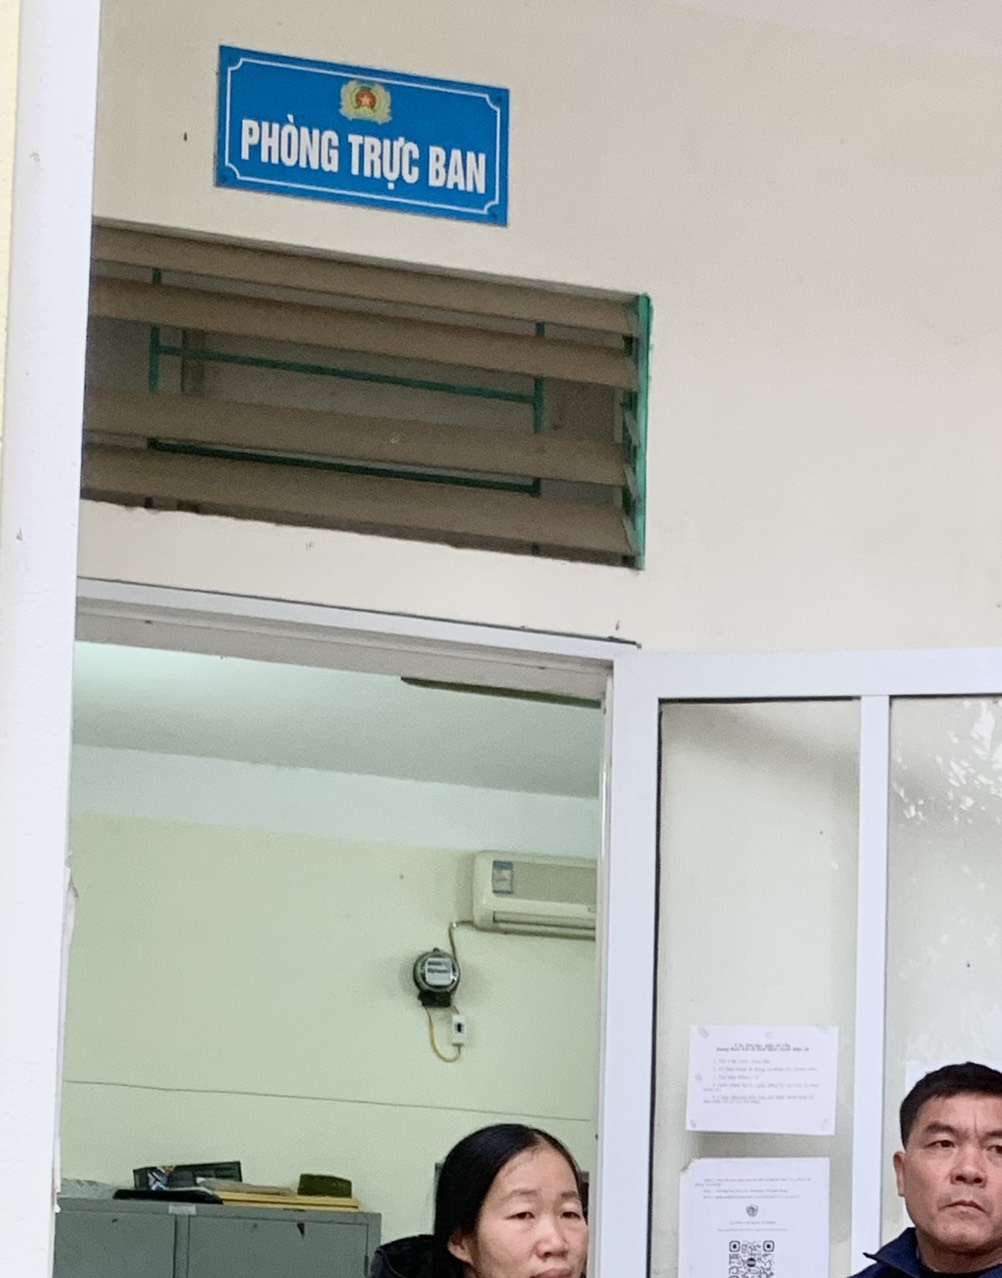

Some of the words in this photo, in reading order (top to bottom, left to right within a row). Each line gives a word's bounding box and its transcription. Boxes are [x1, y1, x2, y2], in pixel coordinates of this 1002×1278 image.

[241, 114, 339, 173] PHÒNG
[348, 134, 420, 190] TRỰC
[428, 145, 487, 194] BAN
